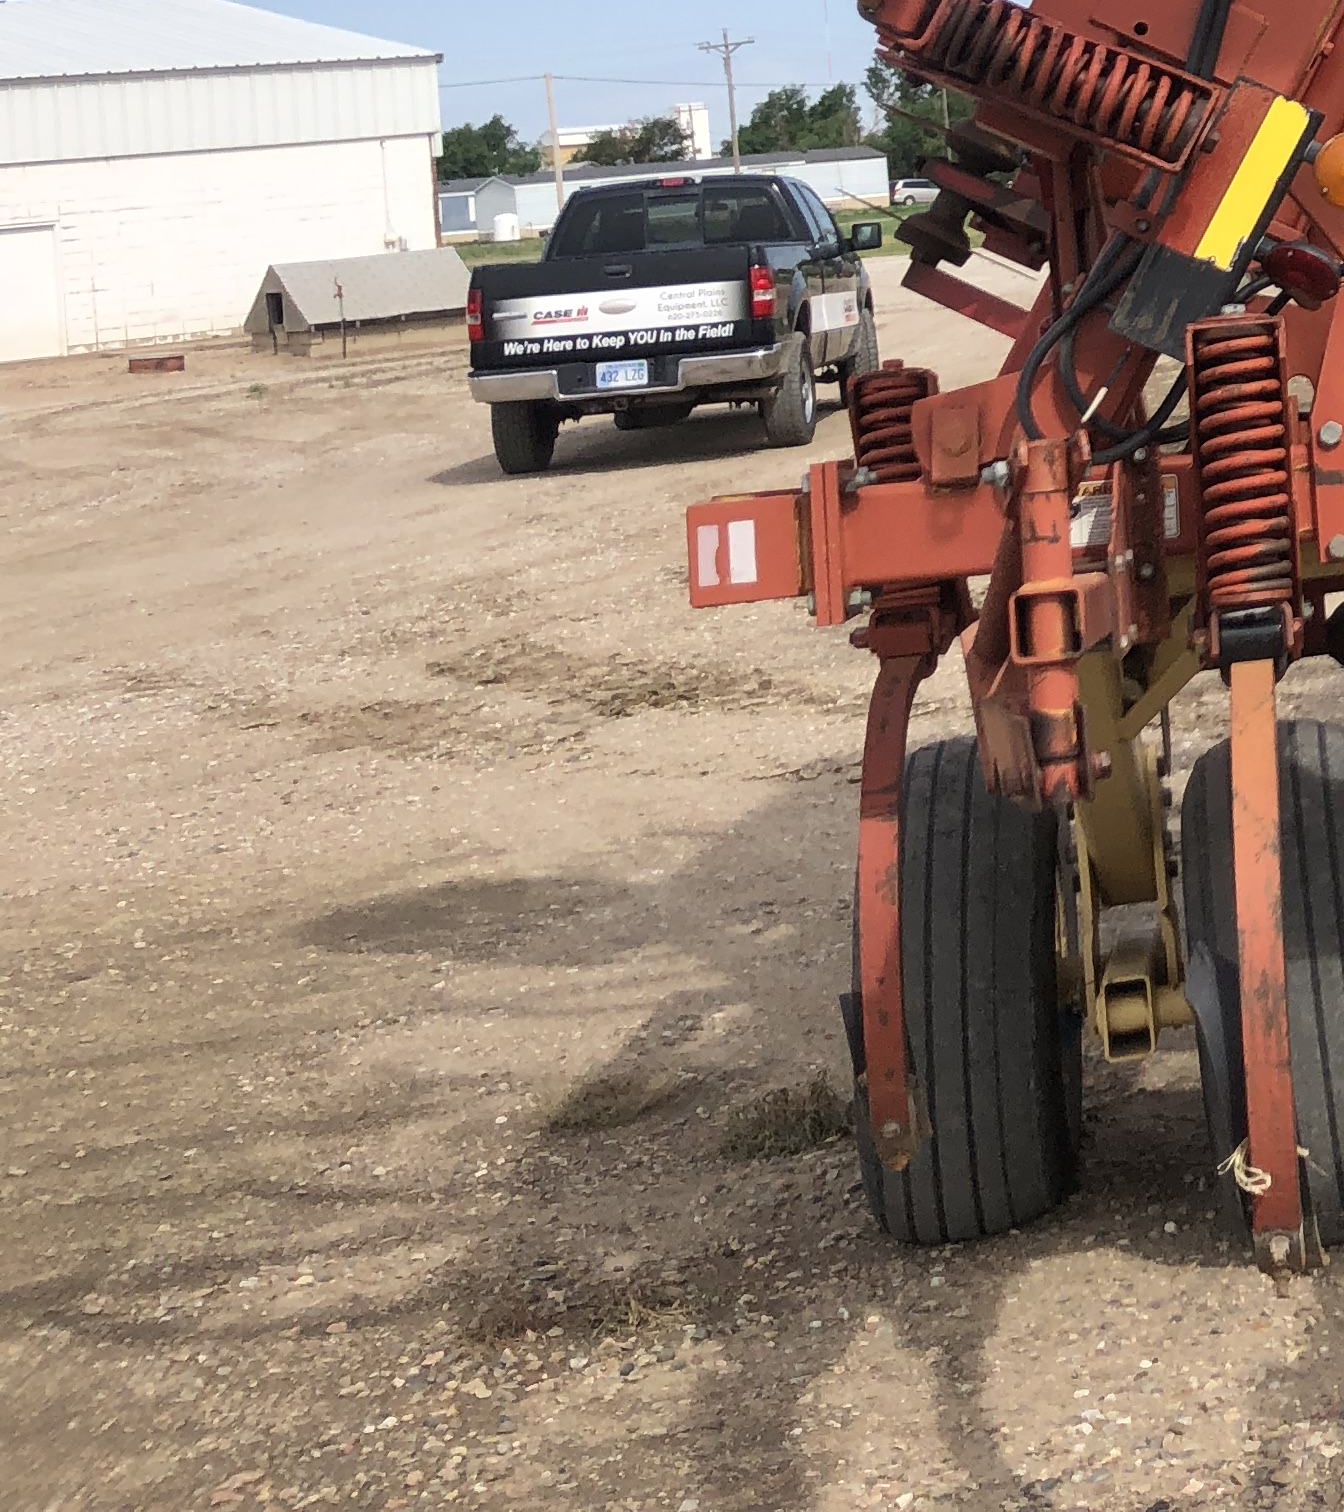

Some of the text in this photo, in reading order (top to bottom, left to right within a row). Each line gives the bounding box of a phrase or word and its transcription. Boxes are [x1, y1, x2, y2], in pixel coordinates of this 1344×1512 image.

[659, 288, 725, 301] Central Plains
[710, 298, 729, 308] LLC
[533, 308, 573, 320] CASE
[503, 340, 541, 356] We're
[542, 338, 573, 352] Here
[576, 336, 589, 350] to
[591, 334, 625, 349] Keep
[628, 329, 658, 346] YOU
[674, 326, 696, 341] the
[697, 322, 735, 339] Field!
[600, 368, 645, 383] 432 LZG
